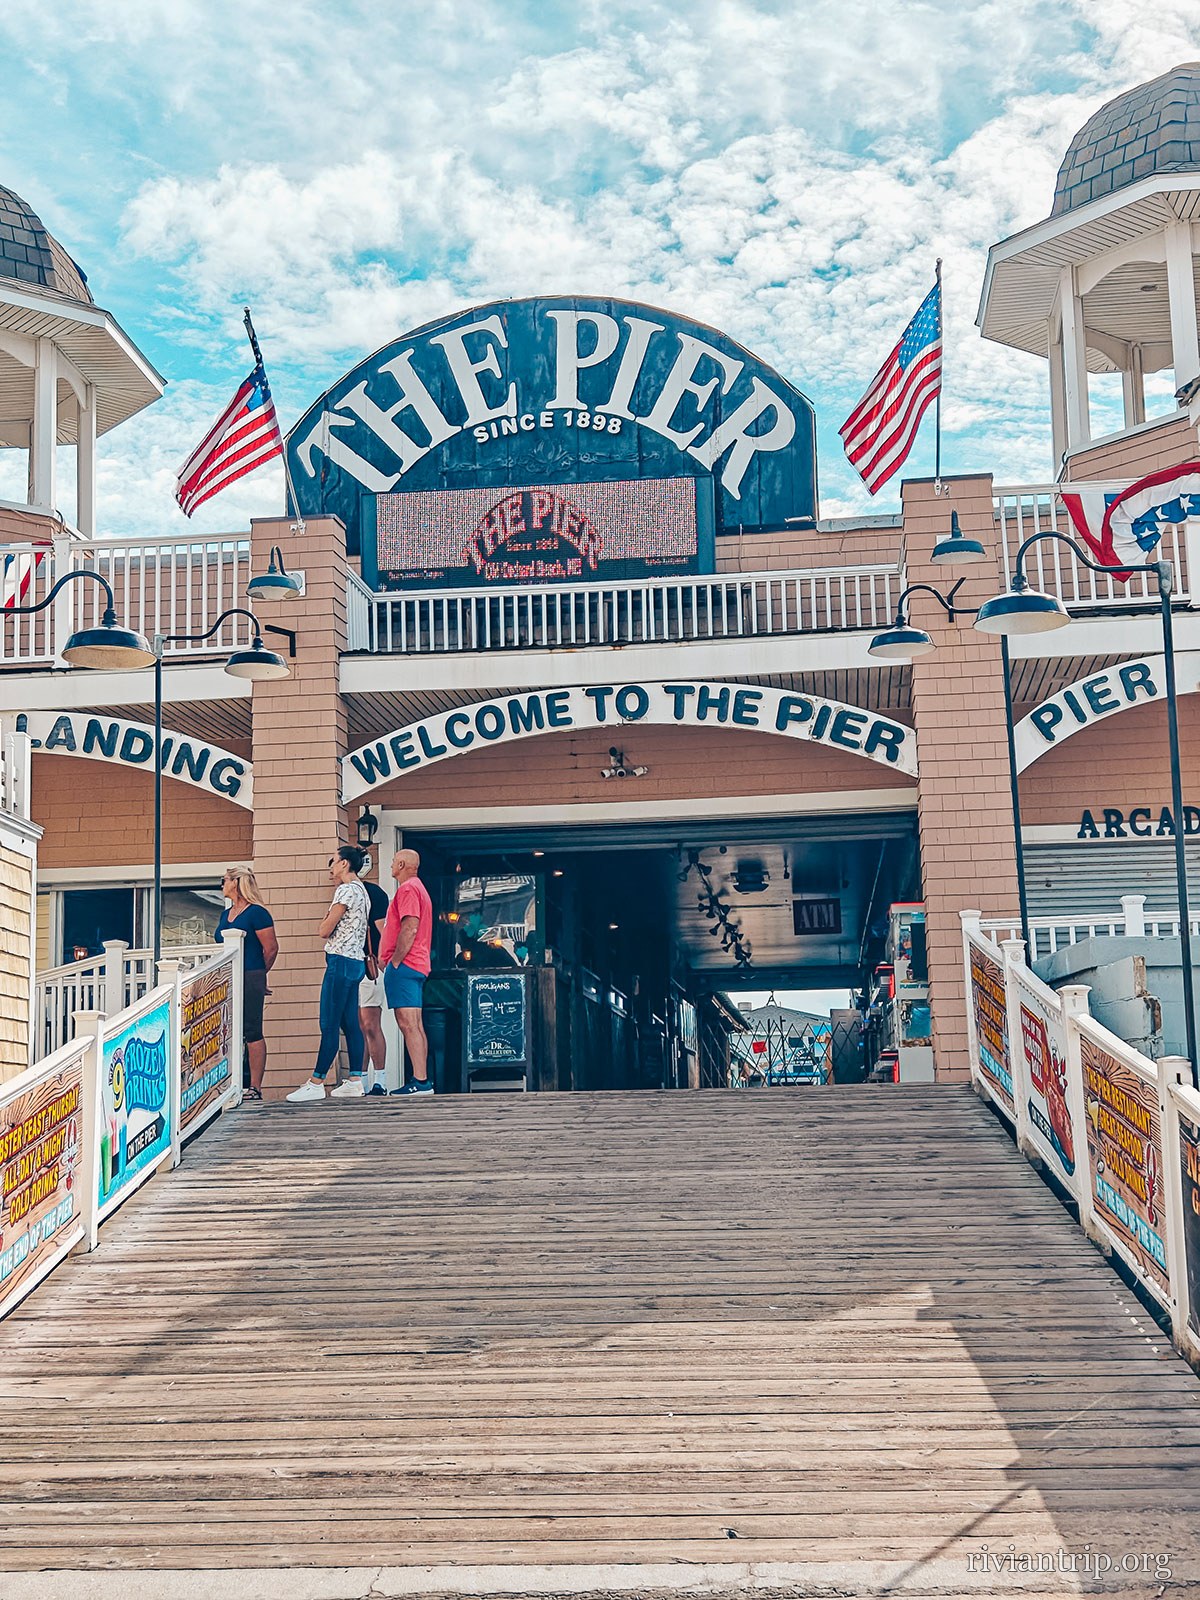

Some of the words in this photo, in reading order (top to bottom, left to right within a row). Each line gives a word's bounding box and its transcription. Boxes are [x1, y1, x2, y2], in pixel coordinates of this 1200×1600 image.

[297, 314, 518, 493] THE
[545, 309, 797, 501] PIER
[473, 412, 554, 443] SINCE
[563, 410, 622, 435] 1898
[461, 492, 527, 575] THE
[529, 490, 604, 571] PIER
[349, 691, 574, 785] WELCOME
[584, 684, 651, 722] TO
[663, 684, 764, 726] THE
[774, 696, 907, 763] PIER
[1030, 662, 1158, 742] PIER
[1077, 805, 1200, 839] ARCAD
[800, 903, 834, 929] ATM
[112, 1058, 125, 1112] 9
[125, 1034, 166, 1080] FROZEN
[23, 1109, 47, 1148] FEAST
[47, 1083, 80, 1132] THURSDAY
[126, 1070, 166, 1113] DRINKS
[1086, 1064, 1099, 1096] THE
[1098, 1071, 1111, 1104] PIER
[1110, 1081, 1152, 1141] RESTAURANT
[3, 1161, 18, 1198] ALL
[19, 1147, 36, 1184] DAY
[35, 1142, 42, 1171] &
[43, 1124, 67, 1167] NIGHT
[135, 1132, 146, 1153] THE
[145, 1124, 158, 1147] PIER
[1099, 1104, 1117, 1141] GREAT
[1116, 1117, 1144, 1169] SEAFOOD
[10, 1187, 30, 1227] COLD
[30, 1163, 59, 1210] DRINKS
[1102, 1178, 1117, 1215] THE
[1115, 1191, 1129, 1228] END
[1128, 1205, 1138, 1236] OF
[1136, 1214, 1150, 1253] THE
[1149, 1228, 1167, 1270] PIER
[14, 1230, 30, 1268] END
[30, 1219, 42, 1252] OF
[42, 1206, 57, 1242] THE
[57, 1192, 74, 1230] PIER
